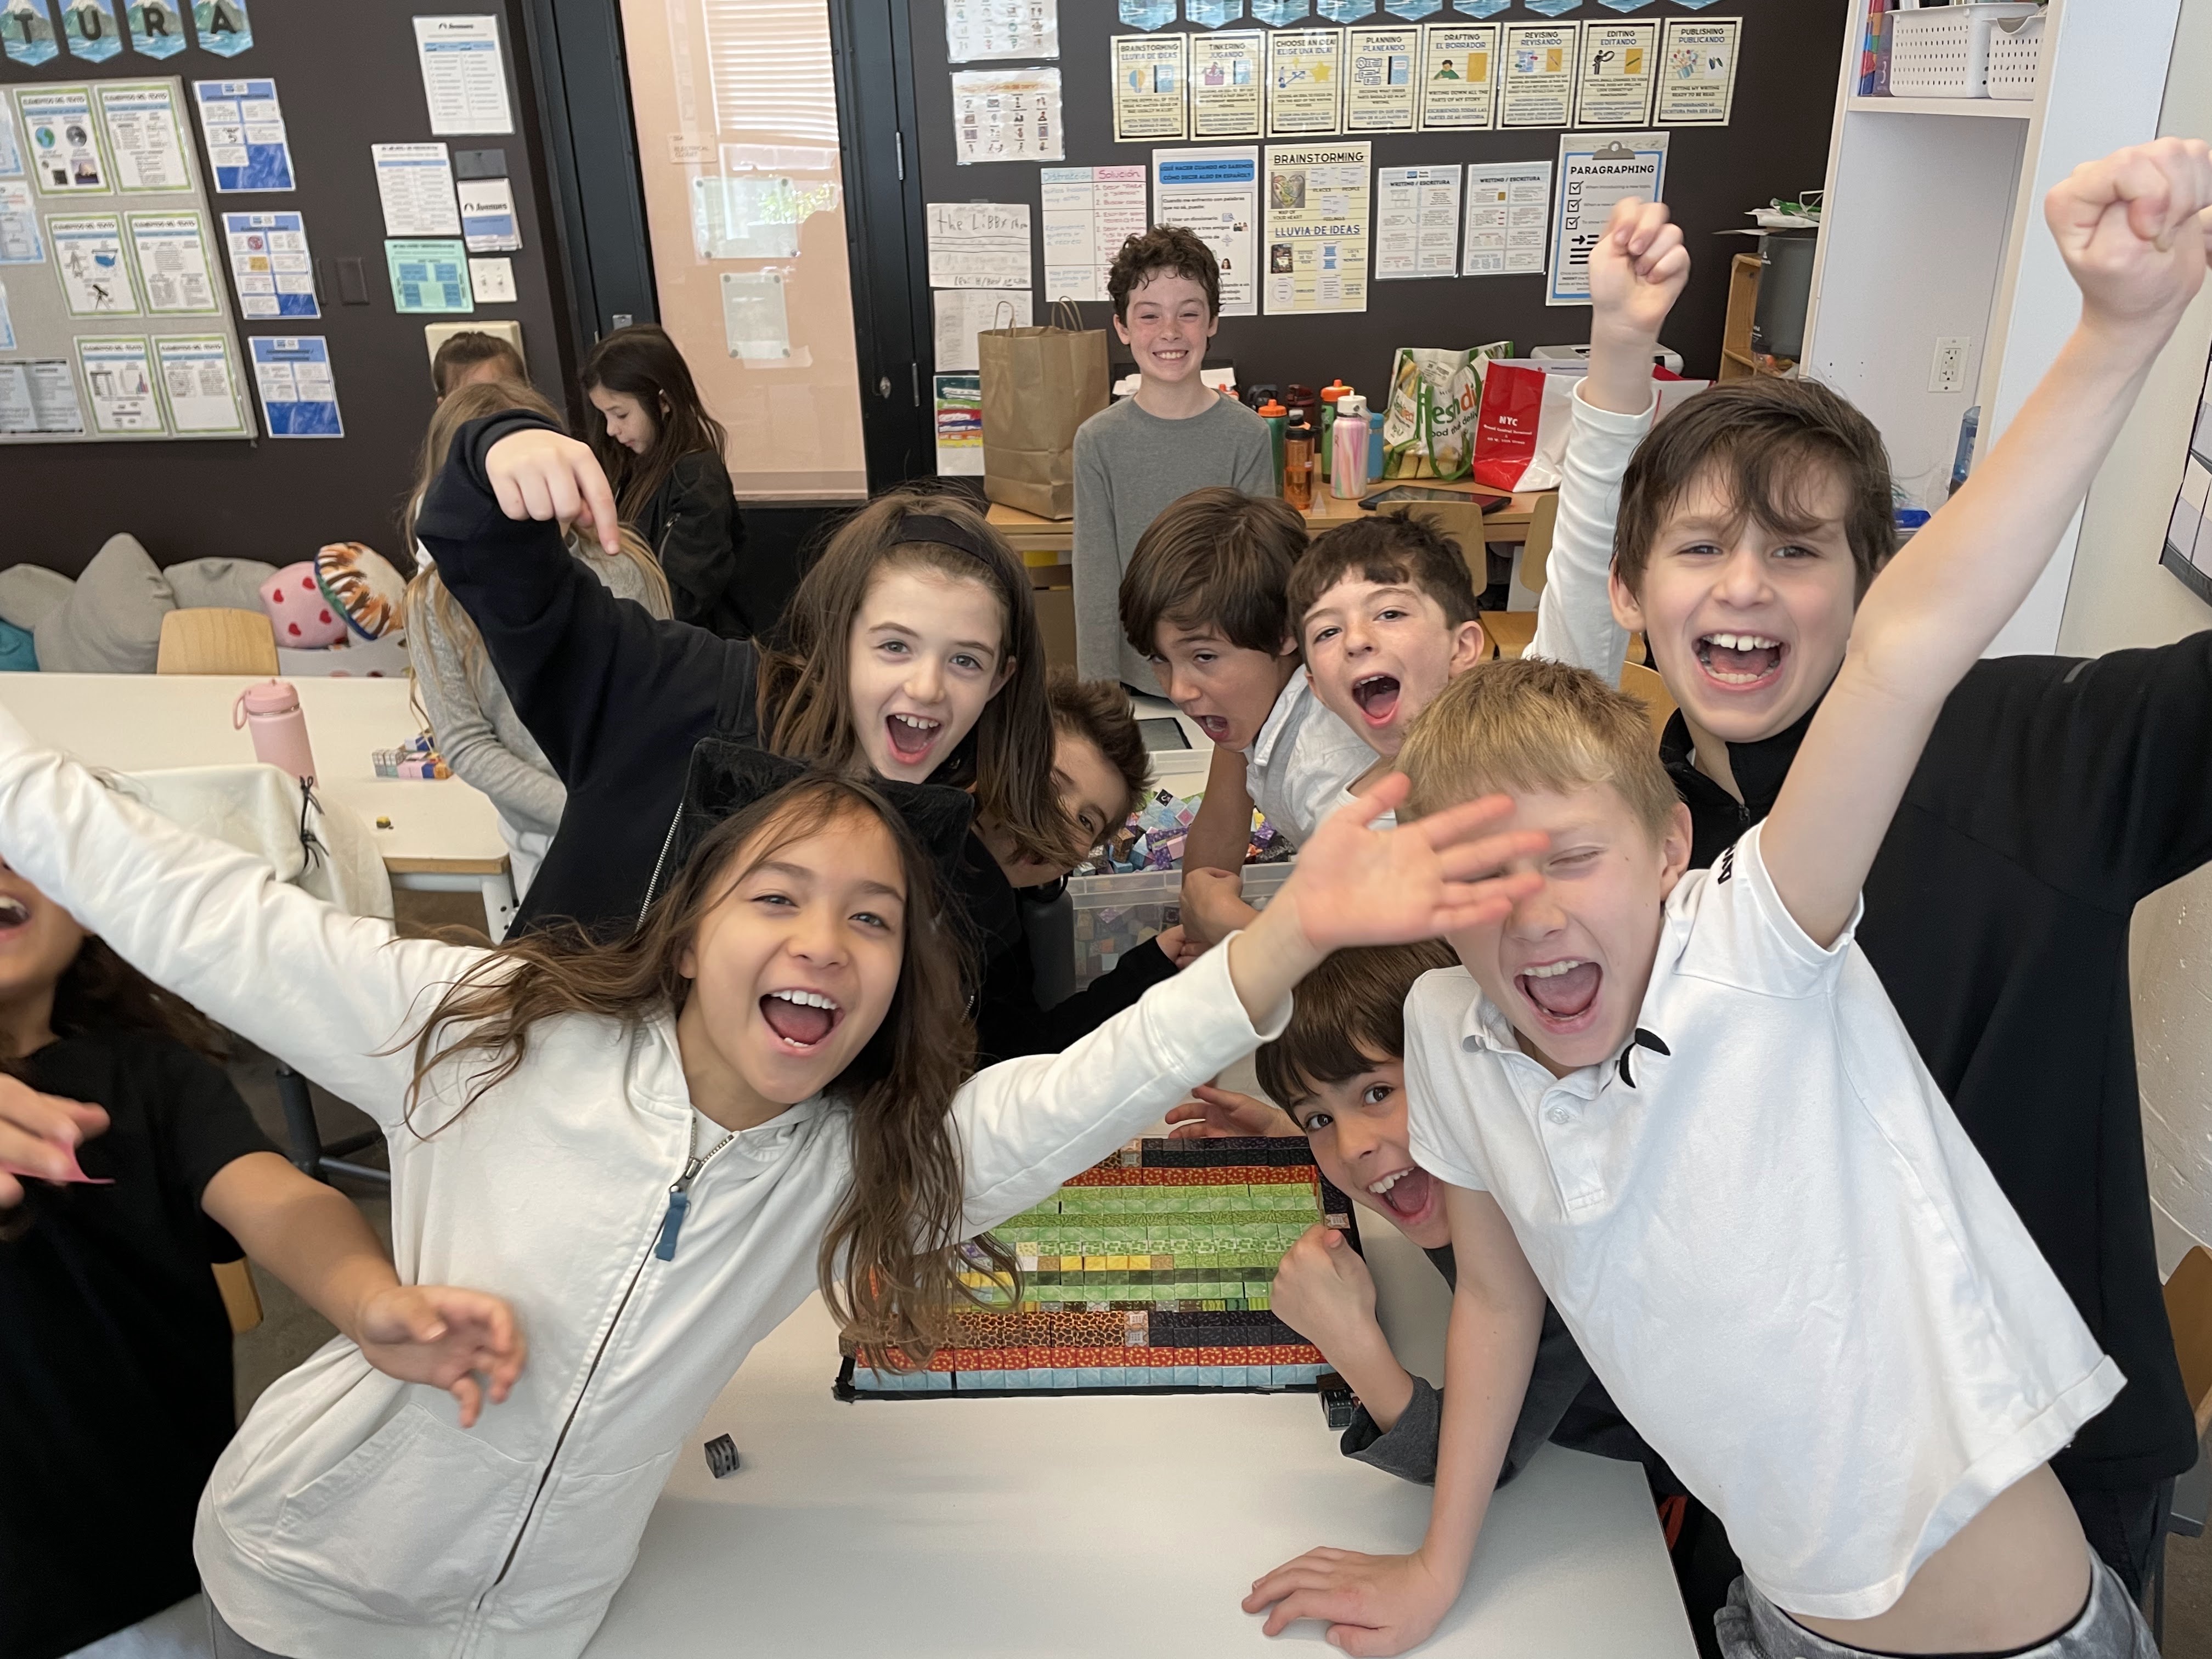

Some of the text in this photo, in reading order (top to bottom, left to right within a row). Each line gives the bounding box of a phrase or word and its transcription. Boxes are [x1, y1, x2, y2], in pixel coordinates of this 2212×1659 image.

[1274, 153, 1364, 163] BRAINSTORMING
[1099, 170, 1140, 179] Solución
[1571, 165, 1654, 174] PARAGRAPHING
[936, 209, 963, 234] the
[1275, 224, 1359, 236] LLUVIA DE IDEAS
[1432, 428, 1448, 437] ood
[1462, 412, 1477, 425] deliv
[1499, 416, 1518, 426] NYC
